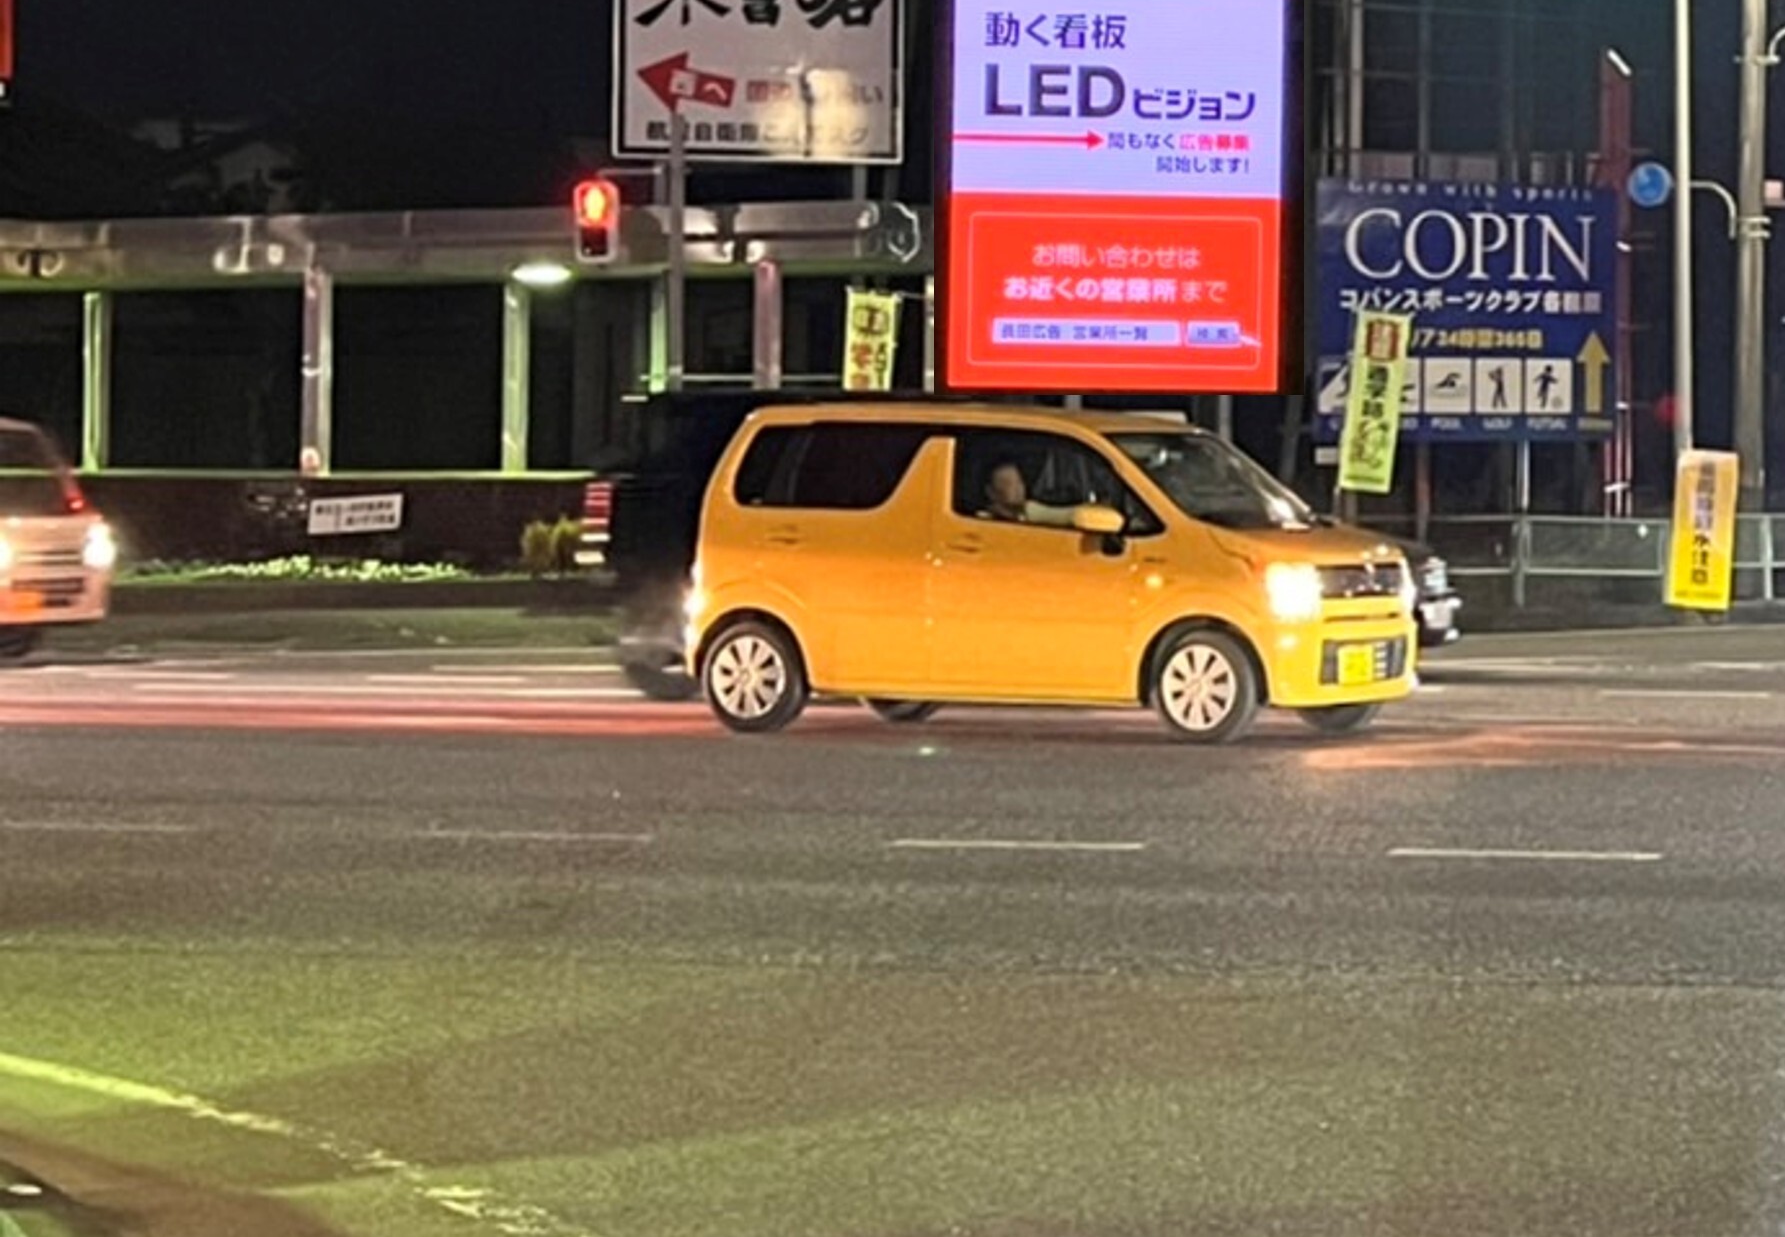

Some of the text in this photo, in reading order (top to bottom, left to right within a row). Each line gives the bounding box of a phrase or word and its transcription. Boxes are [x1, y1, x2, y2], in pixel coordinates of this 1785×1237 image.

[984, 11, 1127, 50] 動く看板
[1032, 243, 1201, 270] お問い合わせは
[1345, 207, 1596, 282] COPIN
[1002, 276, 1228, 304] お近くの営業所まで
